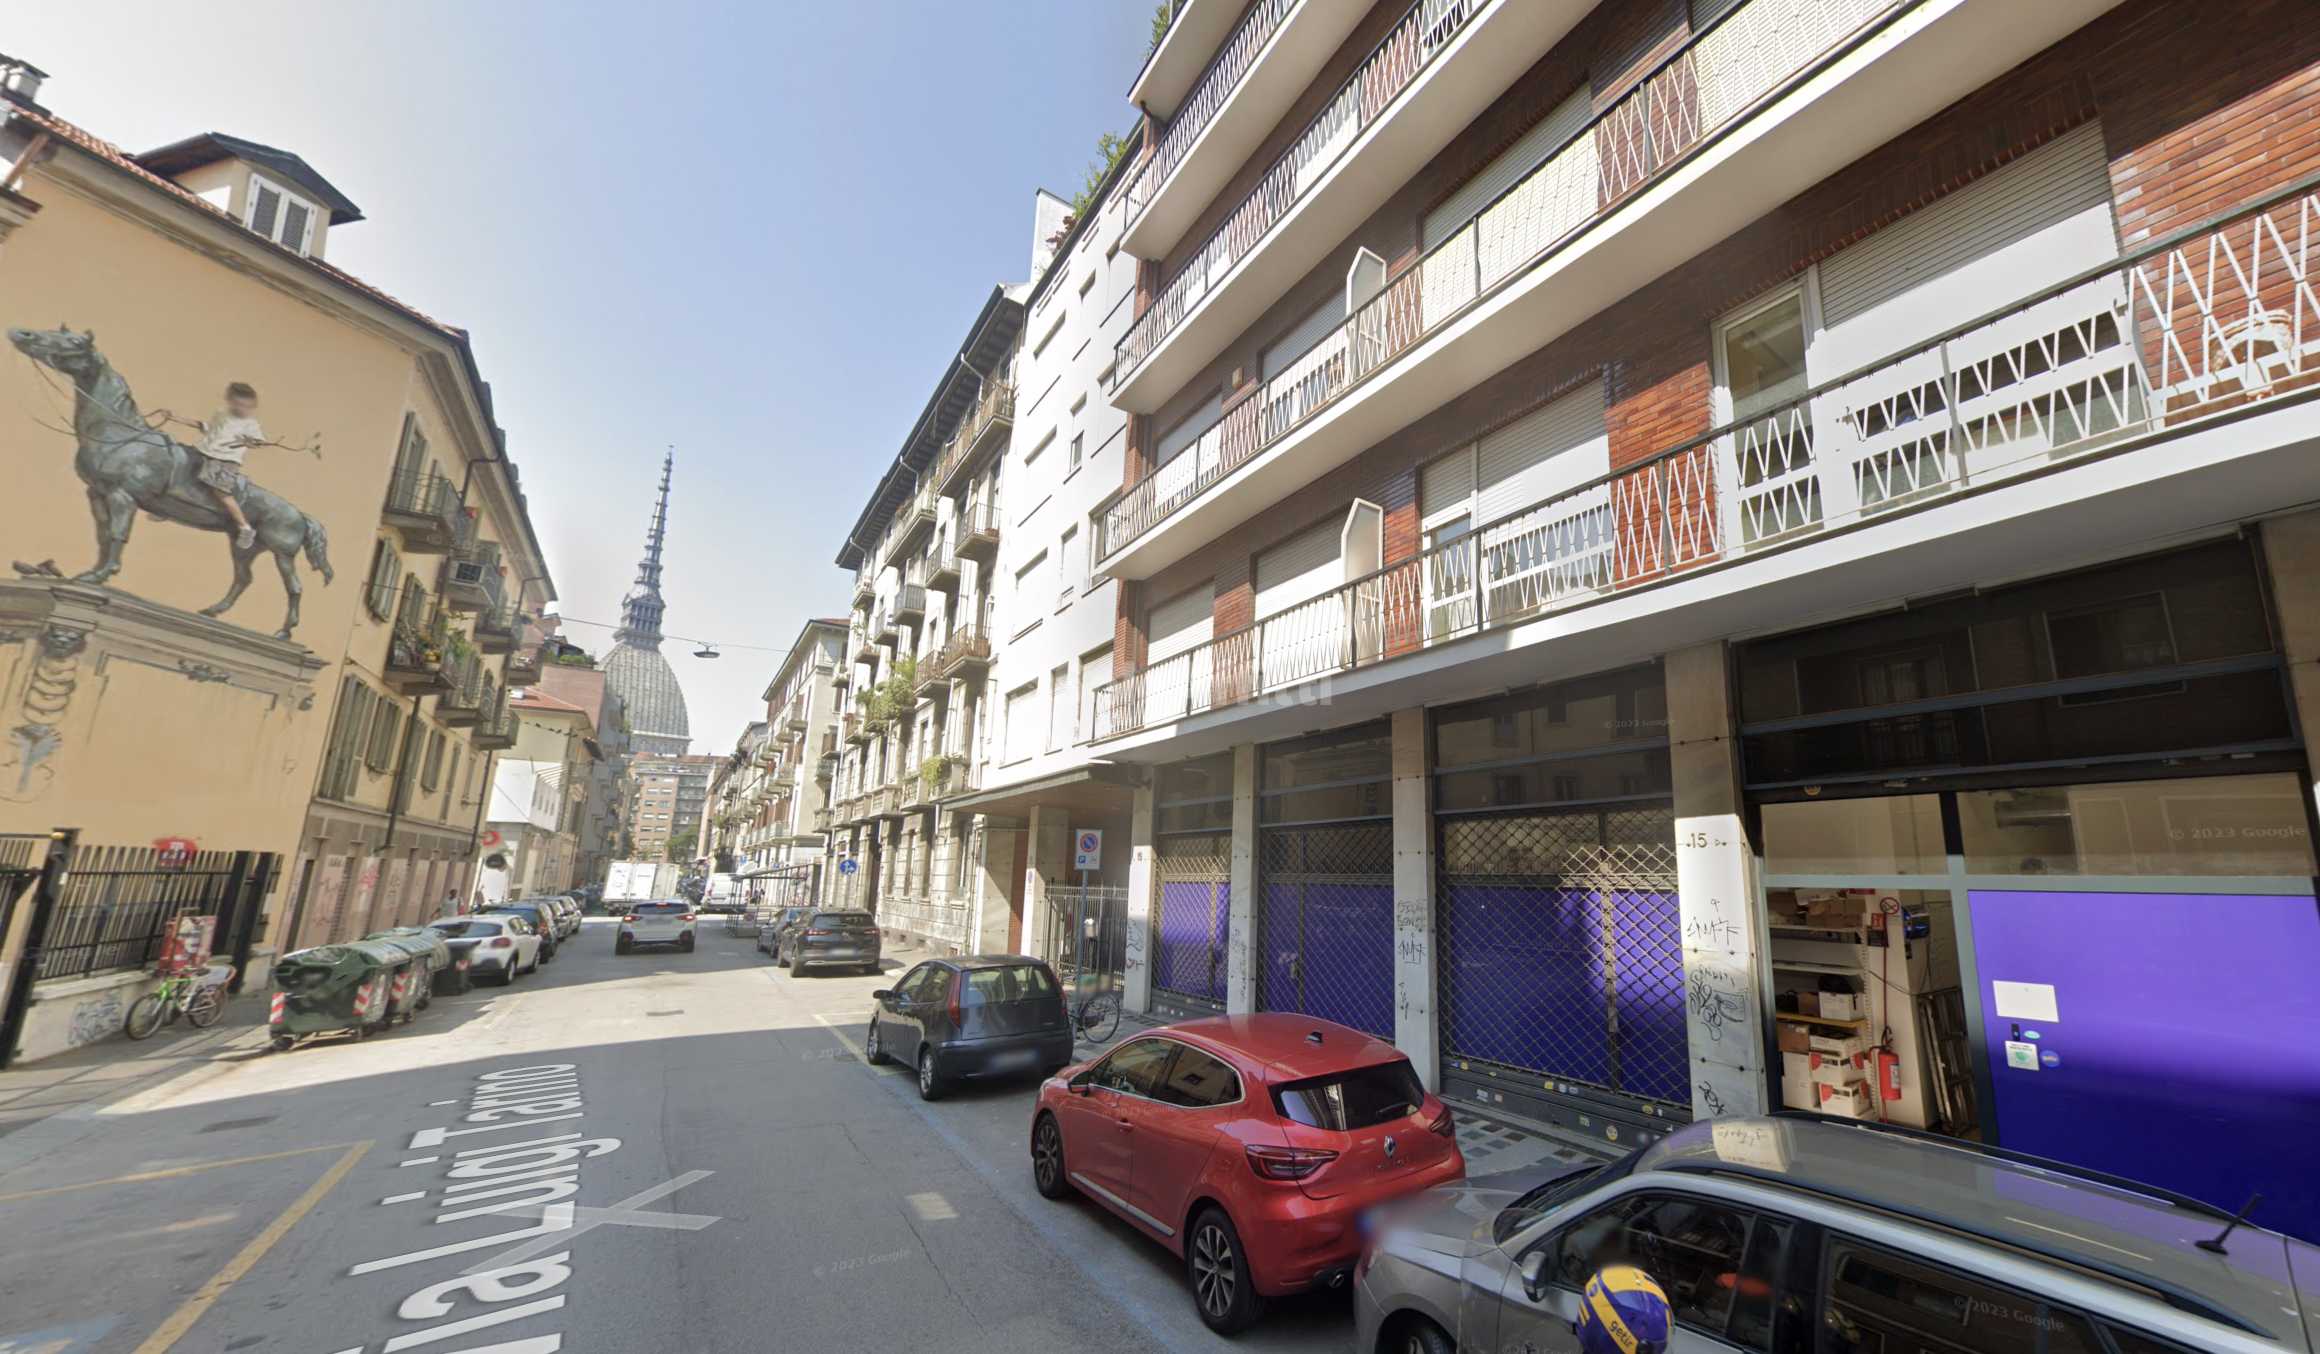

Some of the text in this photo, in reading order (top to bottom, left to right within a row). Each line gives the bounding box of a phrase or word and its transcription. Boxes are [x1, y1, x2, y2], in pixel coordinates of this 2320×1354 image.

[1690, 832, 1708, 849] 15
[333, 1062, 623, 1354] ia Luigi Tarino
